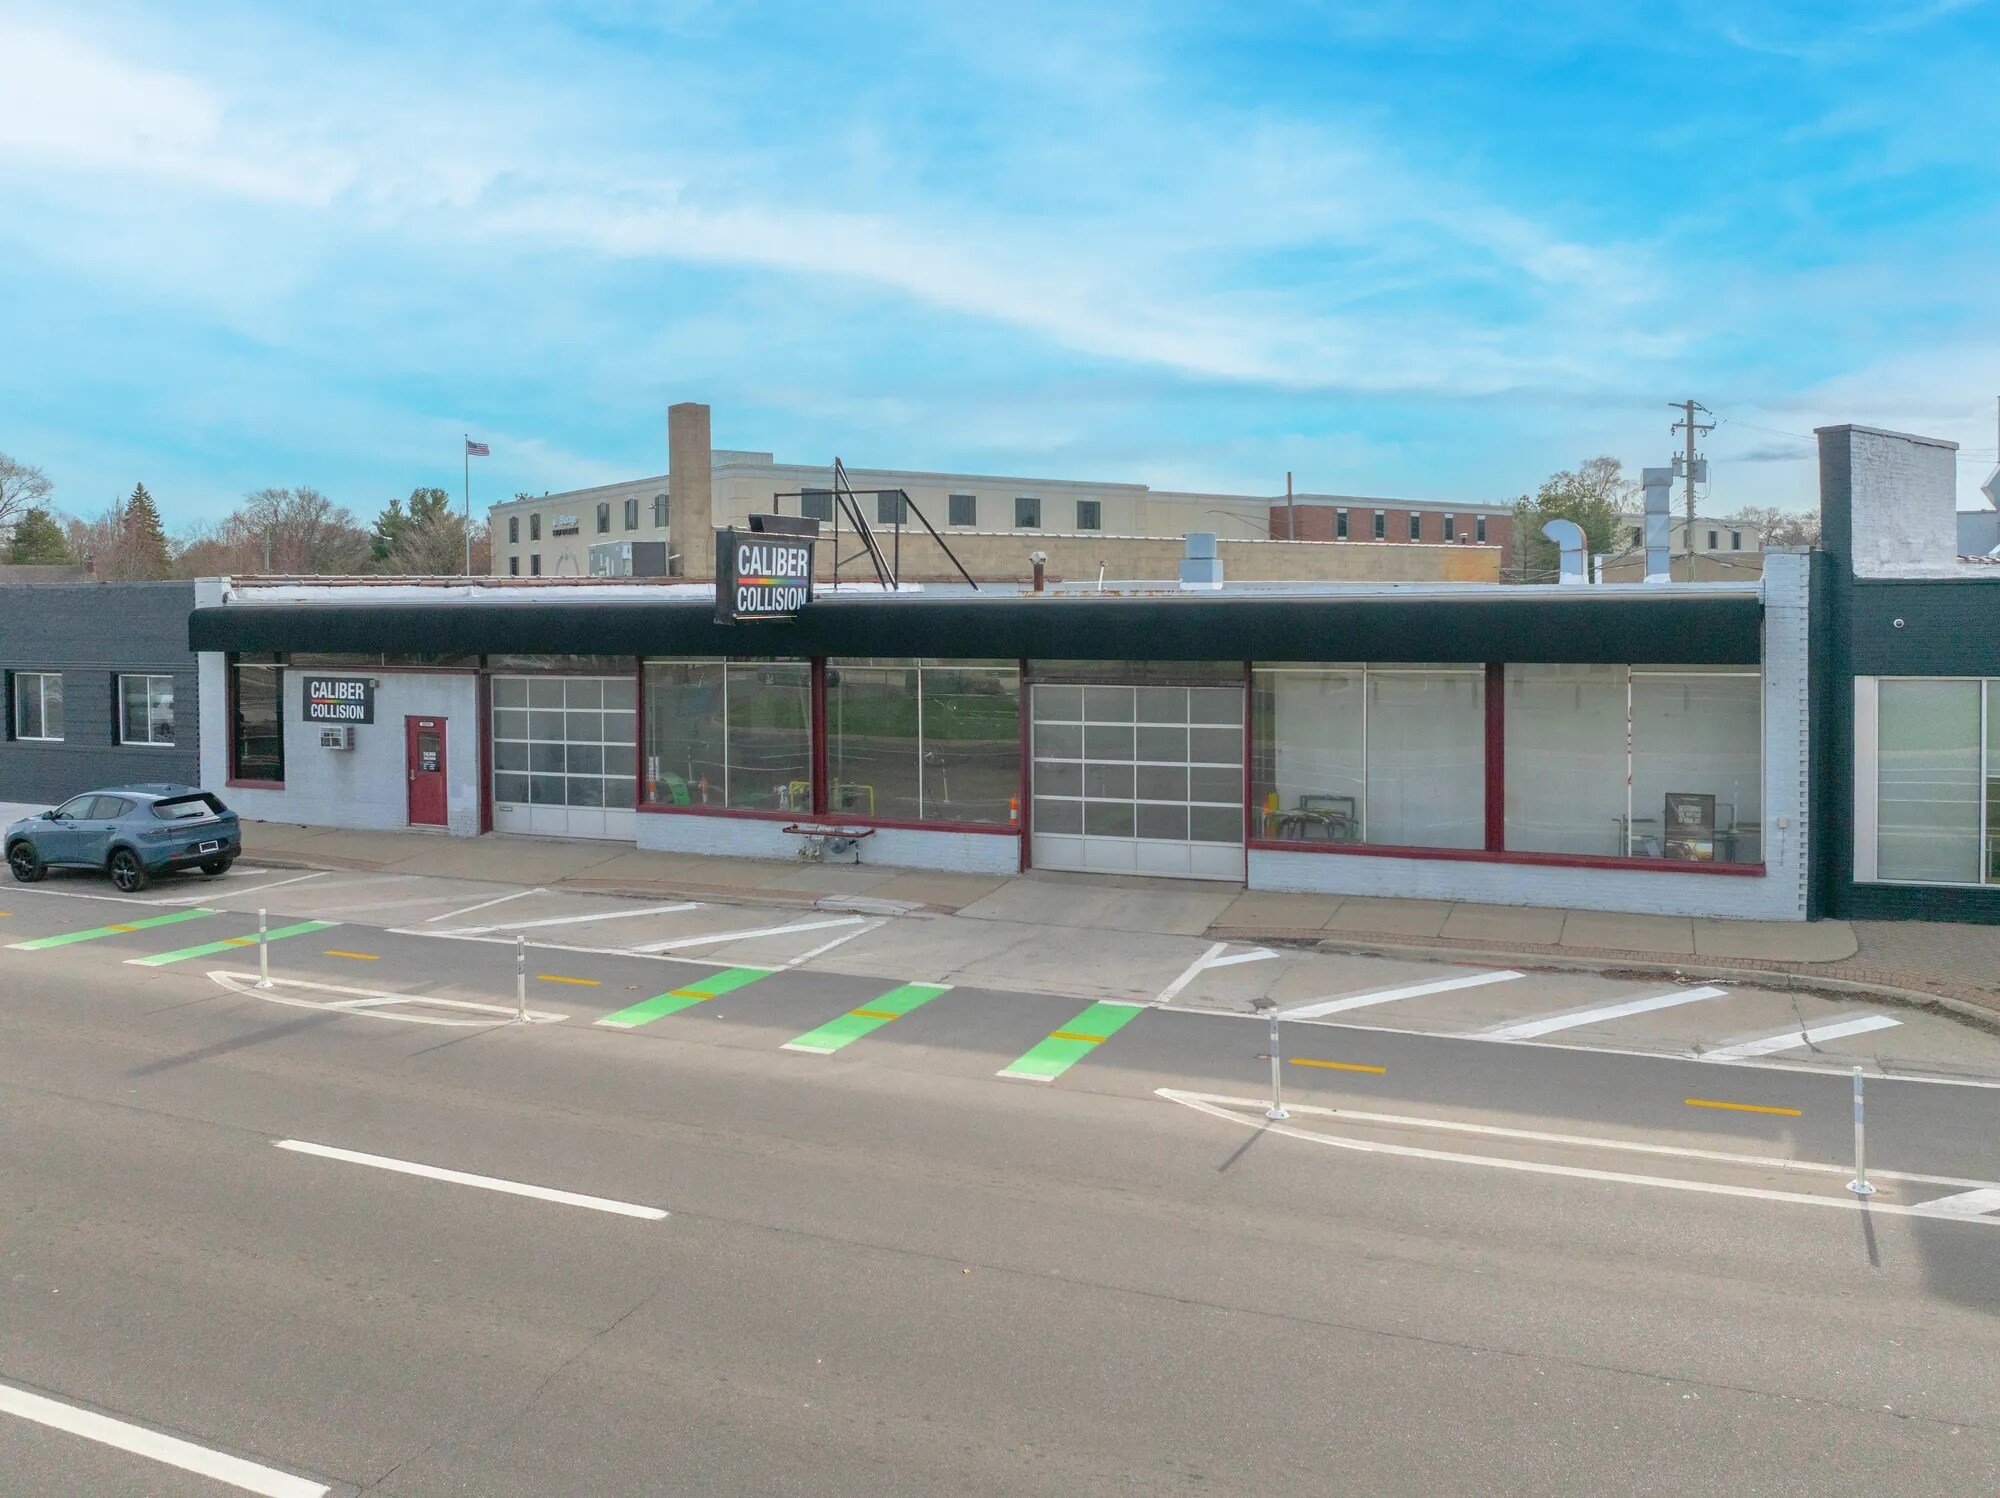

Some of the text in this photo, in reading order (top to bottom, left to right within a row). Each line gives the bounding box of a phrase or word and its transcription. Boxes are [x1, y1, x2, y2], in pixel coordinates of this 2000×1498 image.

[738, 544, 808, 577] CALIBER
[737, 586, 807, 612] COLLISION
[310, 681, 365, 700] CALIBER
[310, 703, 365, 720] COLLISION
